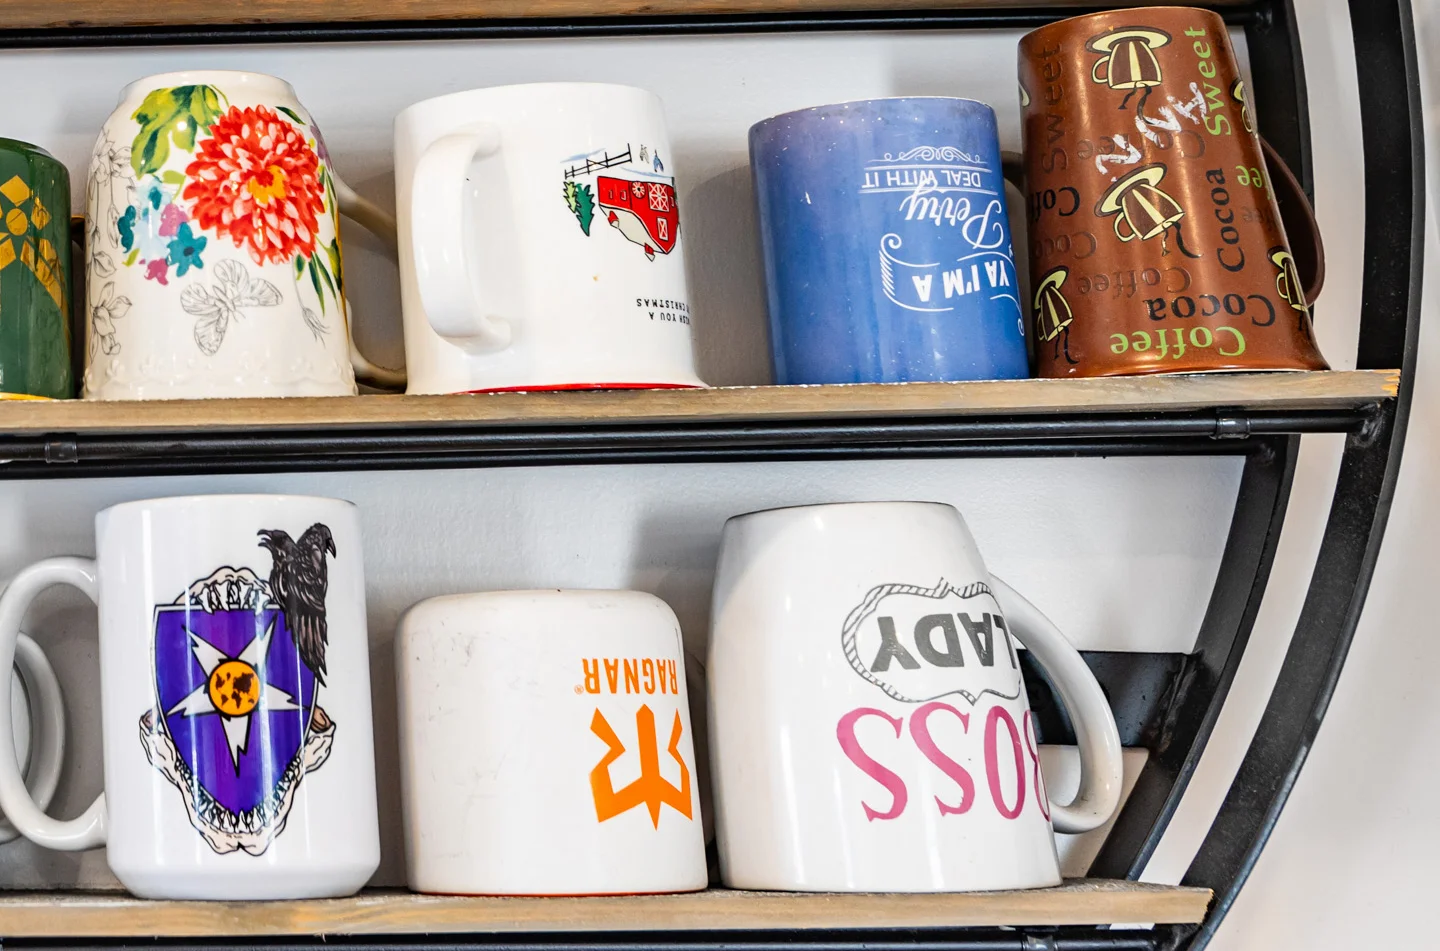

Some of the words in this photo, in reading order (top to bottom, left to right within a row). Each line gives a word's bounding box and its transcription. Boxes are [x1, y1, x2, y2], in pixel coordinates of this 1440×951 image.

[1184, 26, 1232, 136] Sweet
[1038, 43, 1069, 174] Sweet
[861, 169, 880, 189] IT
[887, 169, 936, 187] WITH
[941, 169, 982, 188] DEAL
[898, 177, 1005, 250] Perry
[1205, 167, 1245, 273] Cocoa
[911, 274, 933, 302] A
[942, 264, 981, 299] I'M
[984, 259, 1010, 288] YA
[1077, 266, 1193, 299] Coffee
[636, 298, 686, 312] CHRISTMAS
[648, 311, 655, 321] A
[660, 311, 677, 322] YOU
[1143, 293, 1277, 328] Cocoa
[1109, 325, 1247, 361] Coffee
[869, 611, 1018, 674] LADY
[836, 701, 1052, 823] BOSS
